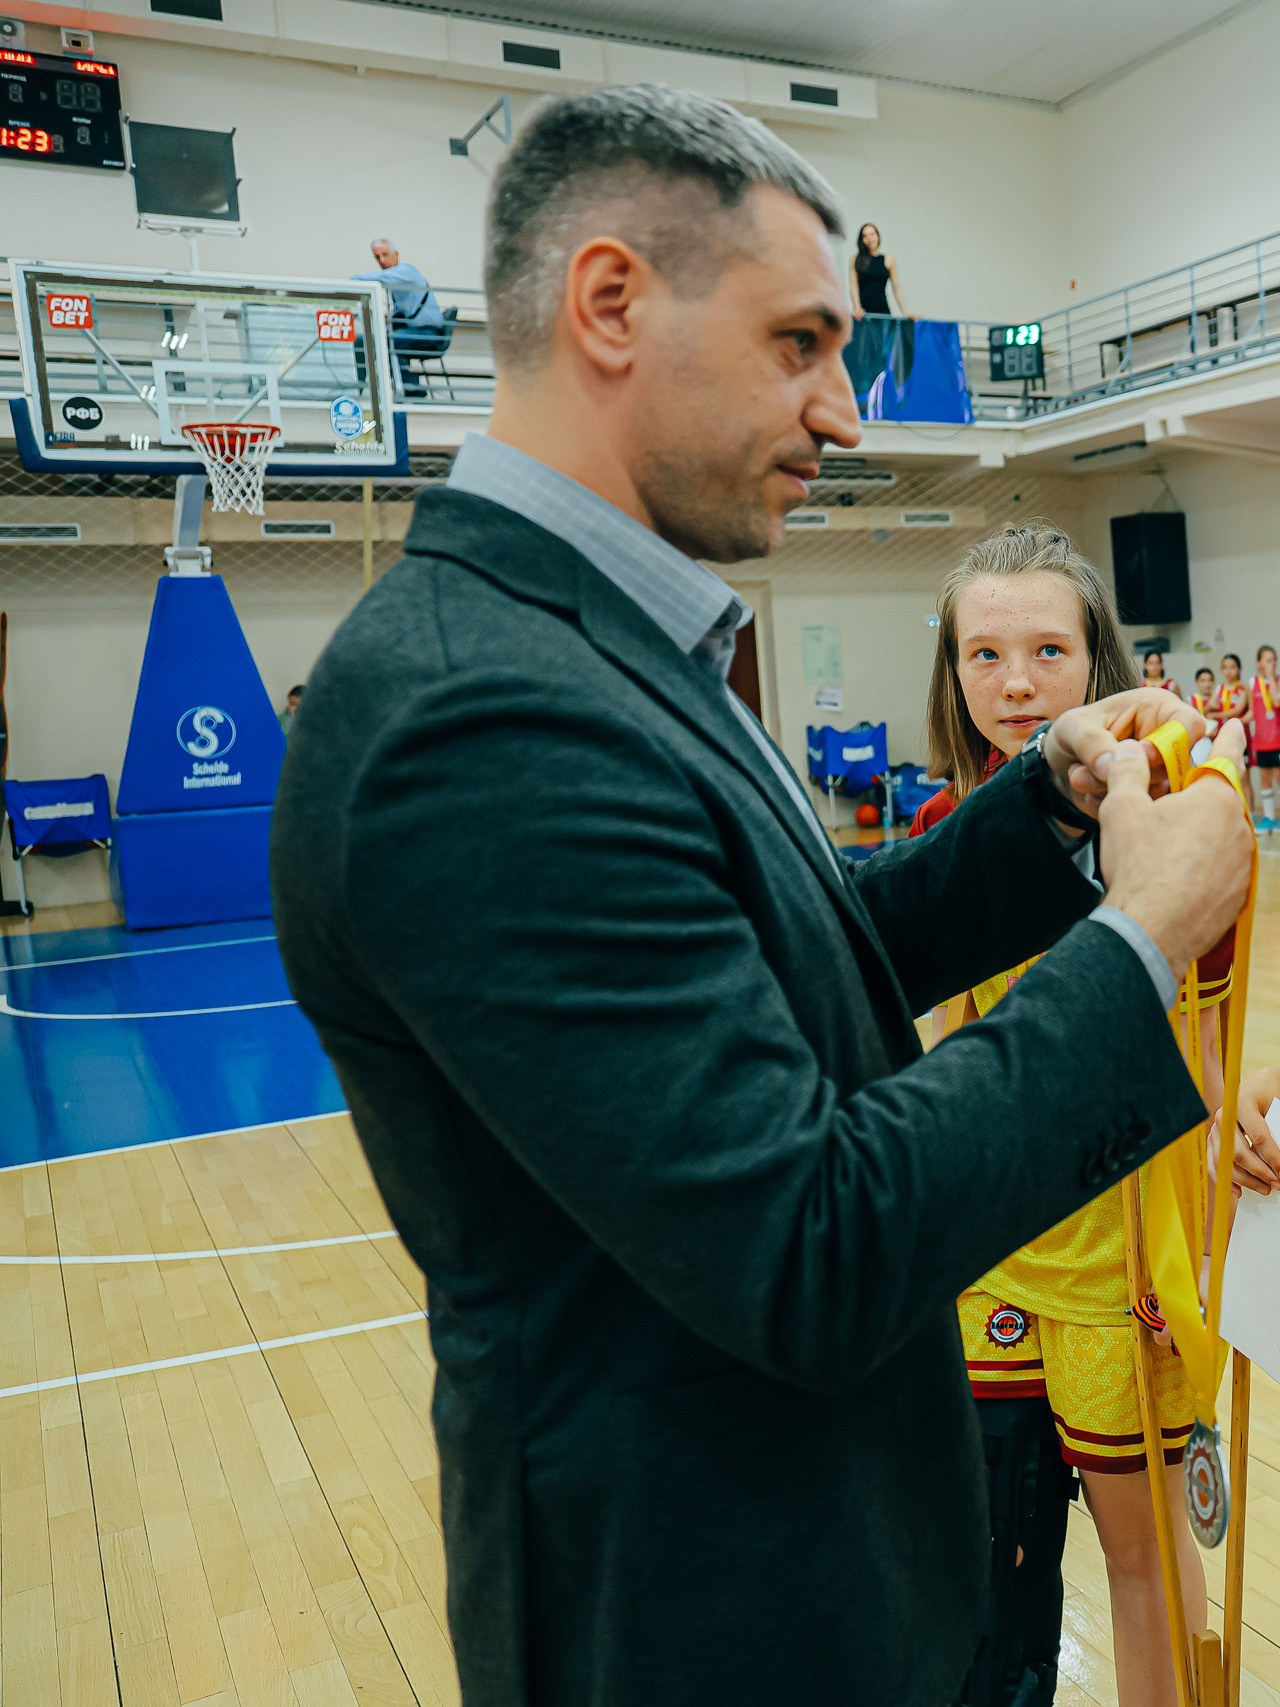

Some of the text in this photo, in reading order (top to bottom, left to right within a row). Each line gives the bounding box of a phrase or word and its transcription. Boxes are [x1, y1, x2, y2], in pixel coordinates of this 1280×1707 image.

[50, 297, 88, 311] FON
[52, 311, 89, 326] BET
[319, 313, 351, 326] FON
[320, 325, 352, 339] BET
[66, 406, 100, 421] РФБ
